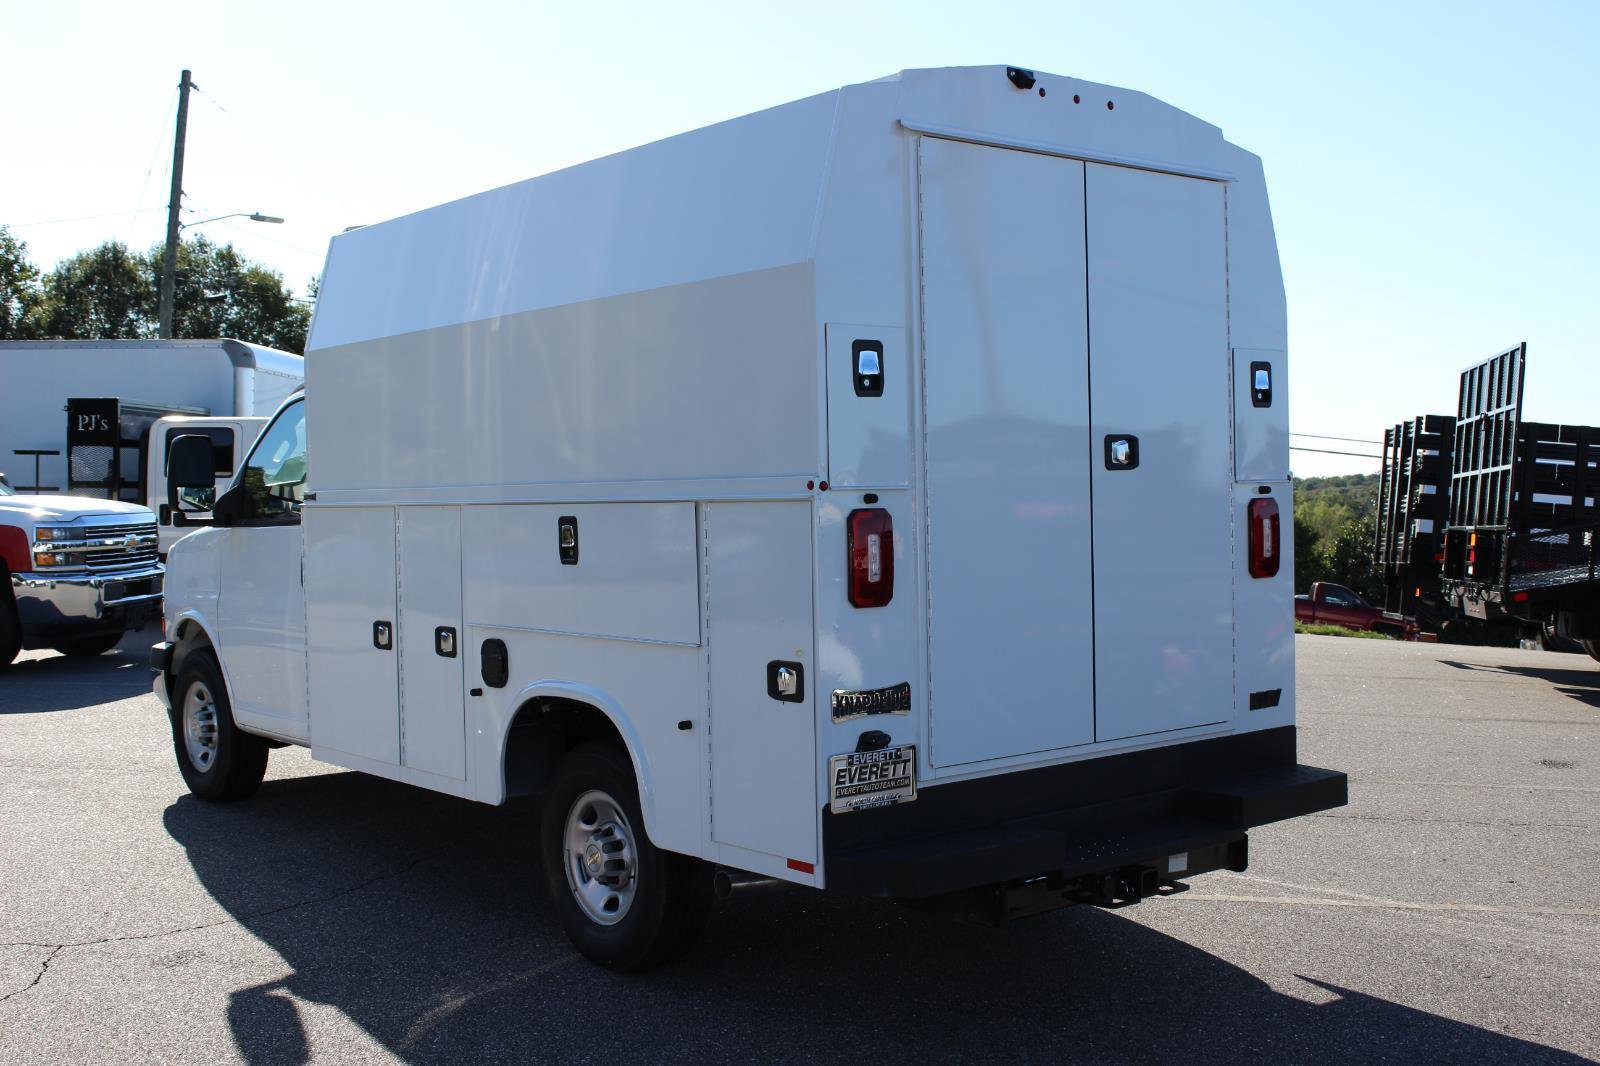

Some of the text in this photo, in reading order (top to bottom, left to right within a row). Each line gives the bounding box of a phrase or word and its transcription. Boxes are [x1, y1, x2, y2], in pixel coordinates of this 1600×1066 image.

[78, 414, 109, 431] PJ's
[853, 751, 896, 765] EVERETT
[835, 760, 911, 786] EVERETT
[836, 778, 911, 797] EVERETTAUTOTEAM.COM
